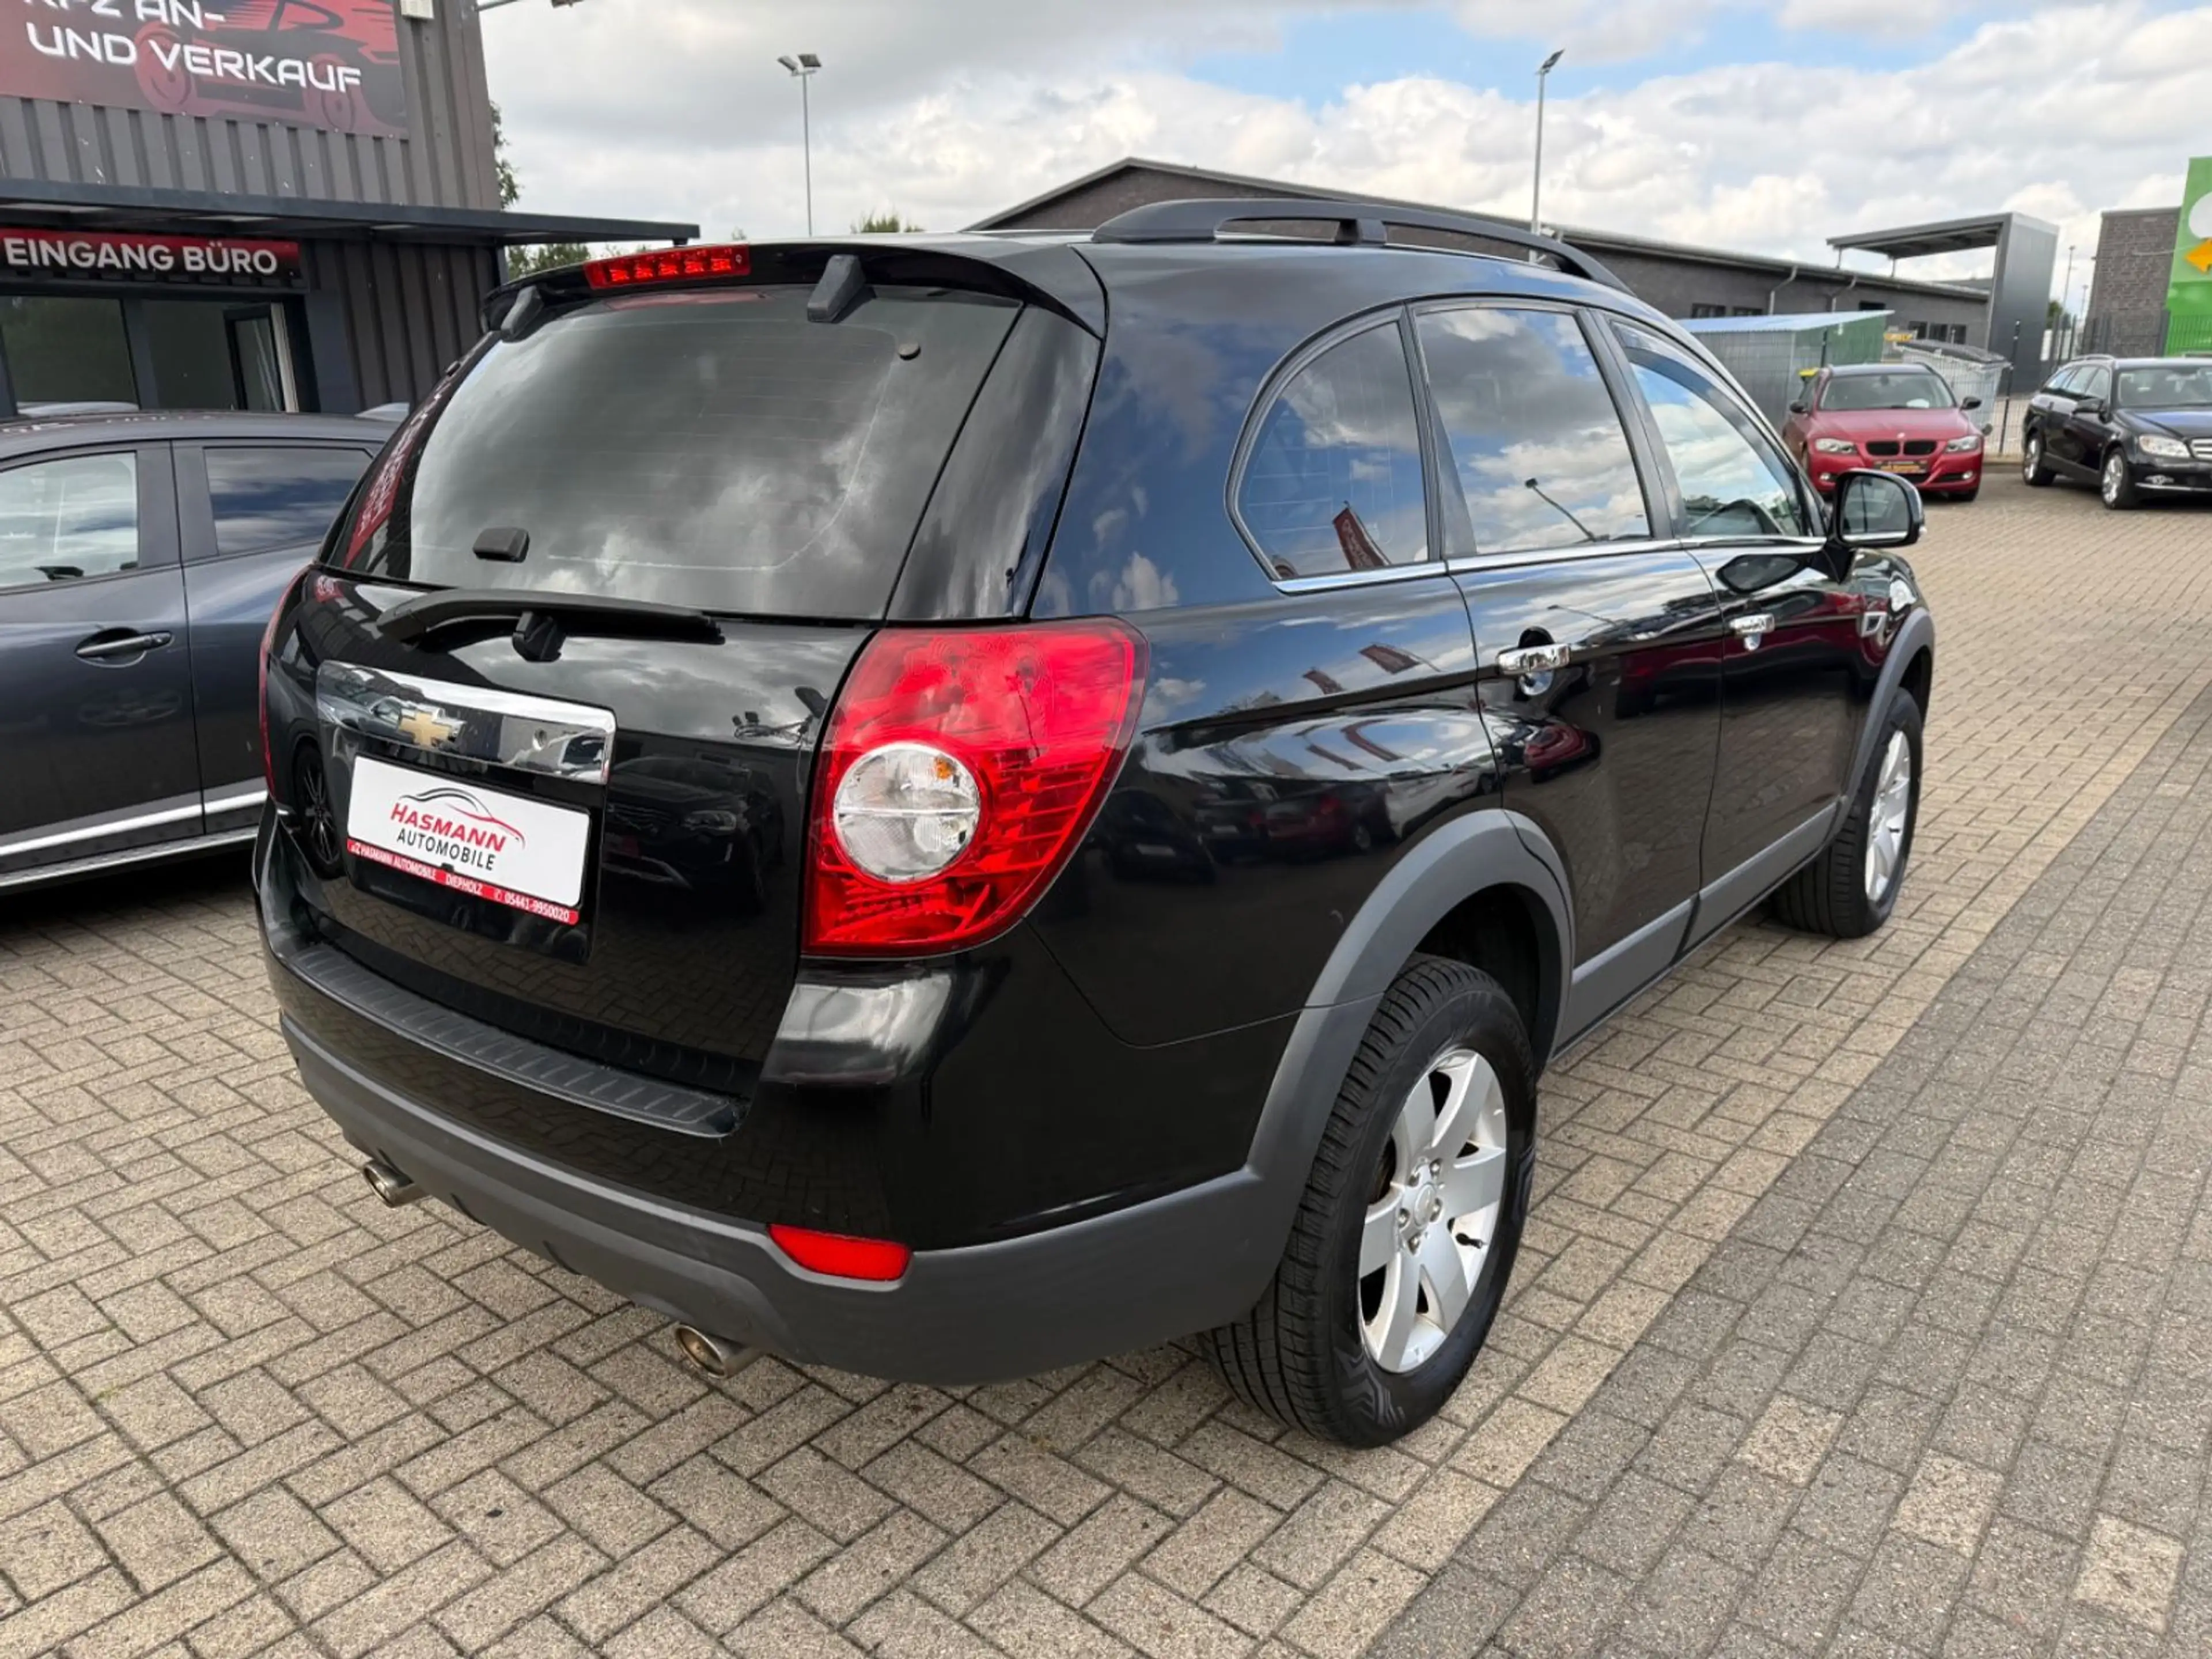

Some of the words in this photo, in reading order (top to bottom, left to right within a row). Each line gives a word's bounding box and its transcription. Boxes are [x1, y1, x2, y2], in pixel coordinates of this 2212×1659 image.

[26, 22, 137, 65] UND
[147, 39, 362, 93] VERKAUF
[3, 237, 174, 271] EINGANG
[182, 241, 277, 274] BÜRO
[391, 802, 506, 852] HASMANN
[397, 828, 496, 870] AUTOMOBILE
[393, 854, 437, 881] AUTOMOBILE
[445, 873, 483, 895] DIEPHOLZ
[504, 891, 570, 922] 05441-9950020
